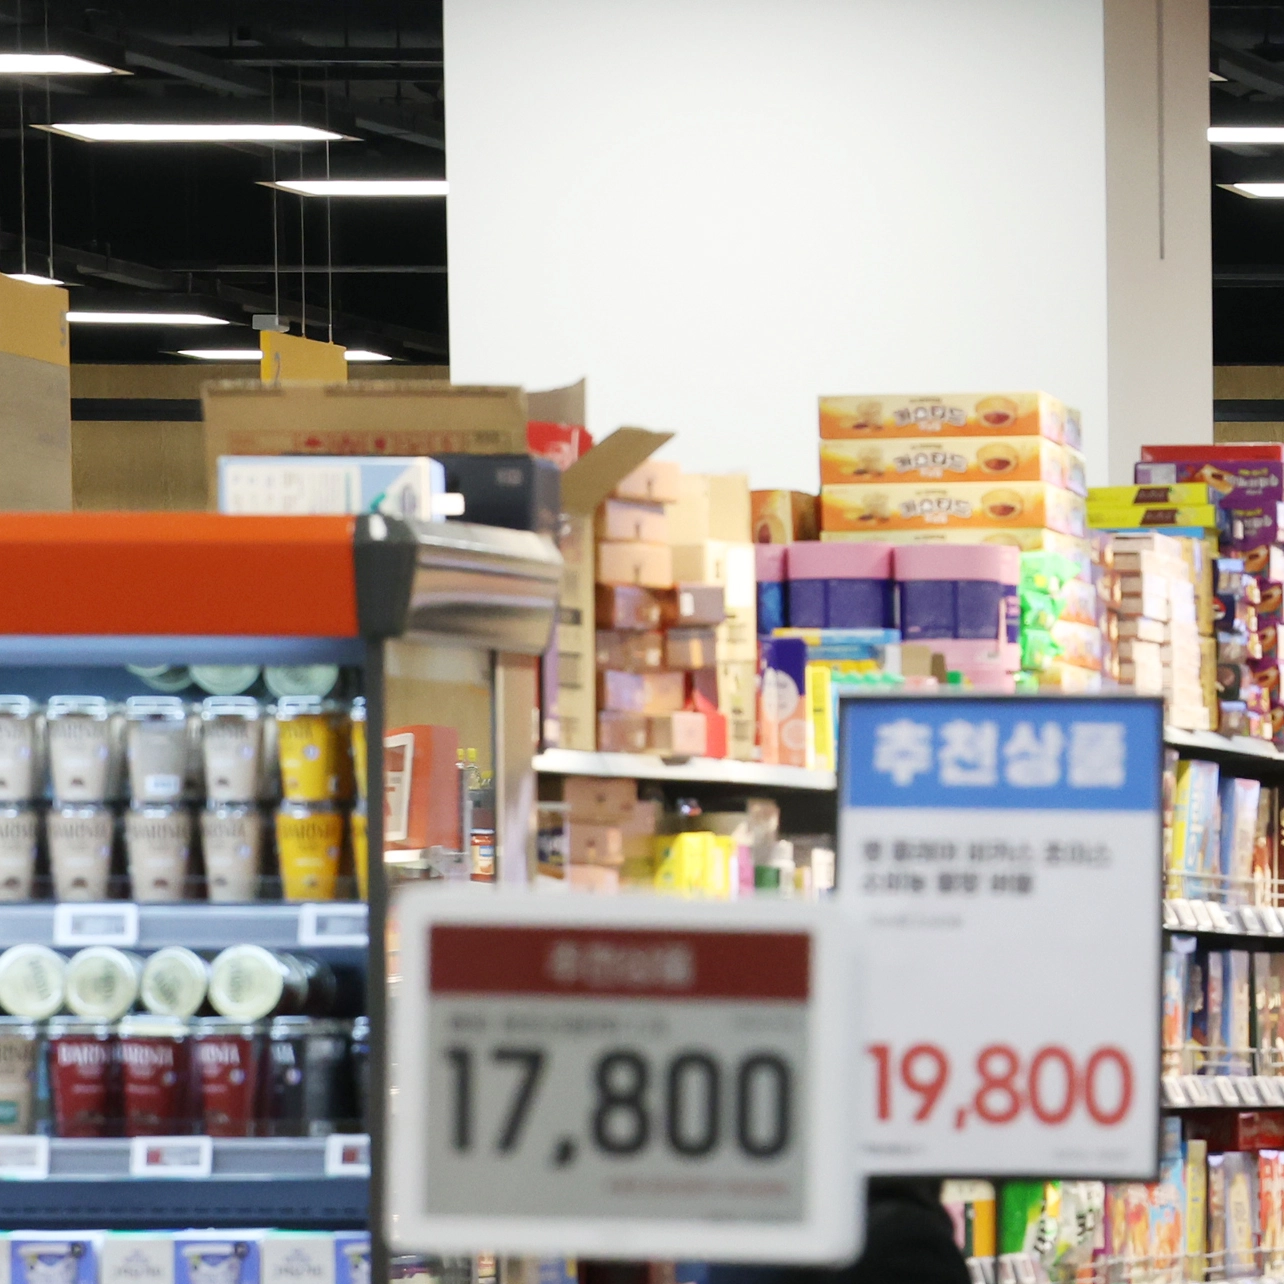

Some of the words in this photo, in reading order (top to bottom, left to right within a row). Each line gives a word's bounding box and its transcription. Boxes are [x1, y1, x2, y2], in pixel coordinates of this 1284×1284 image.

[873, 718, 1126, 788] 추천상품
[447, 1043, 794, 1170] 17,800
[867, 1040, 1136, 1132] 19,800
